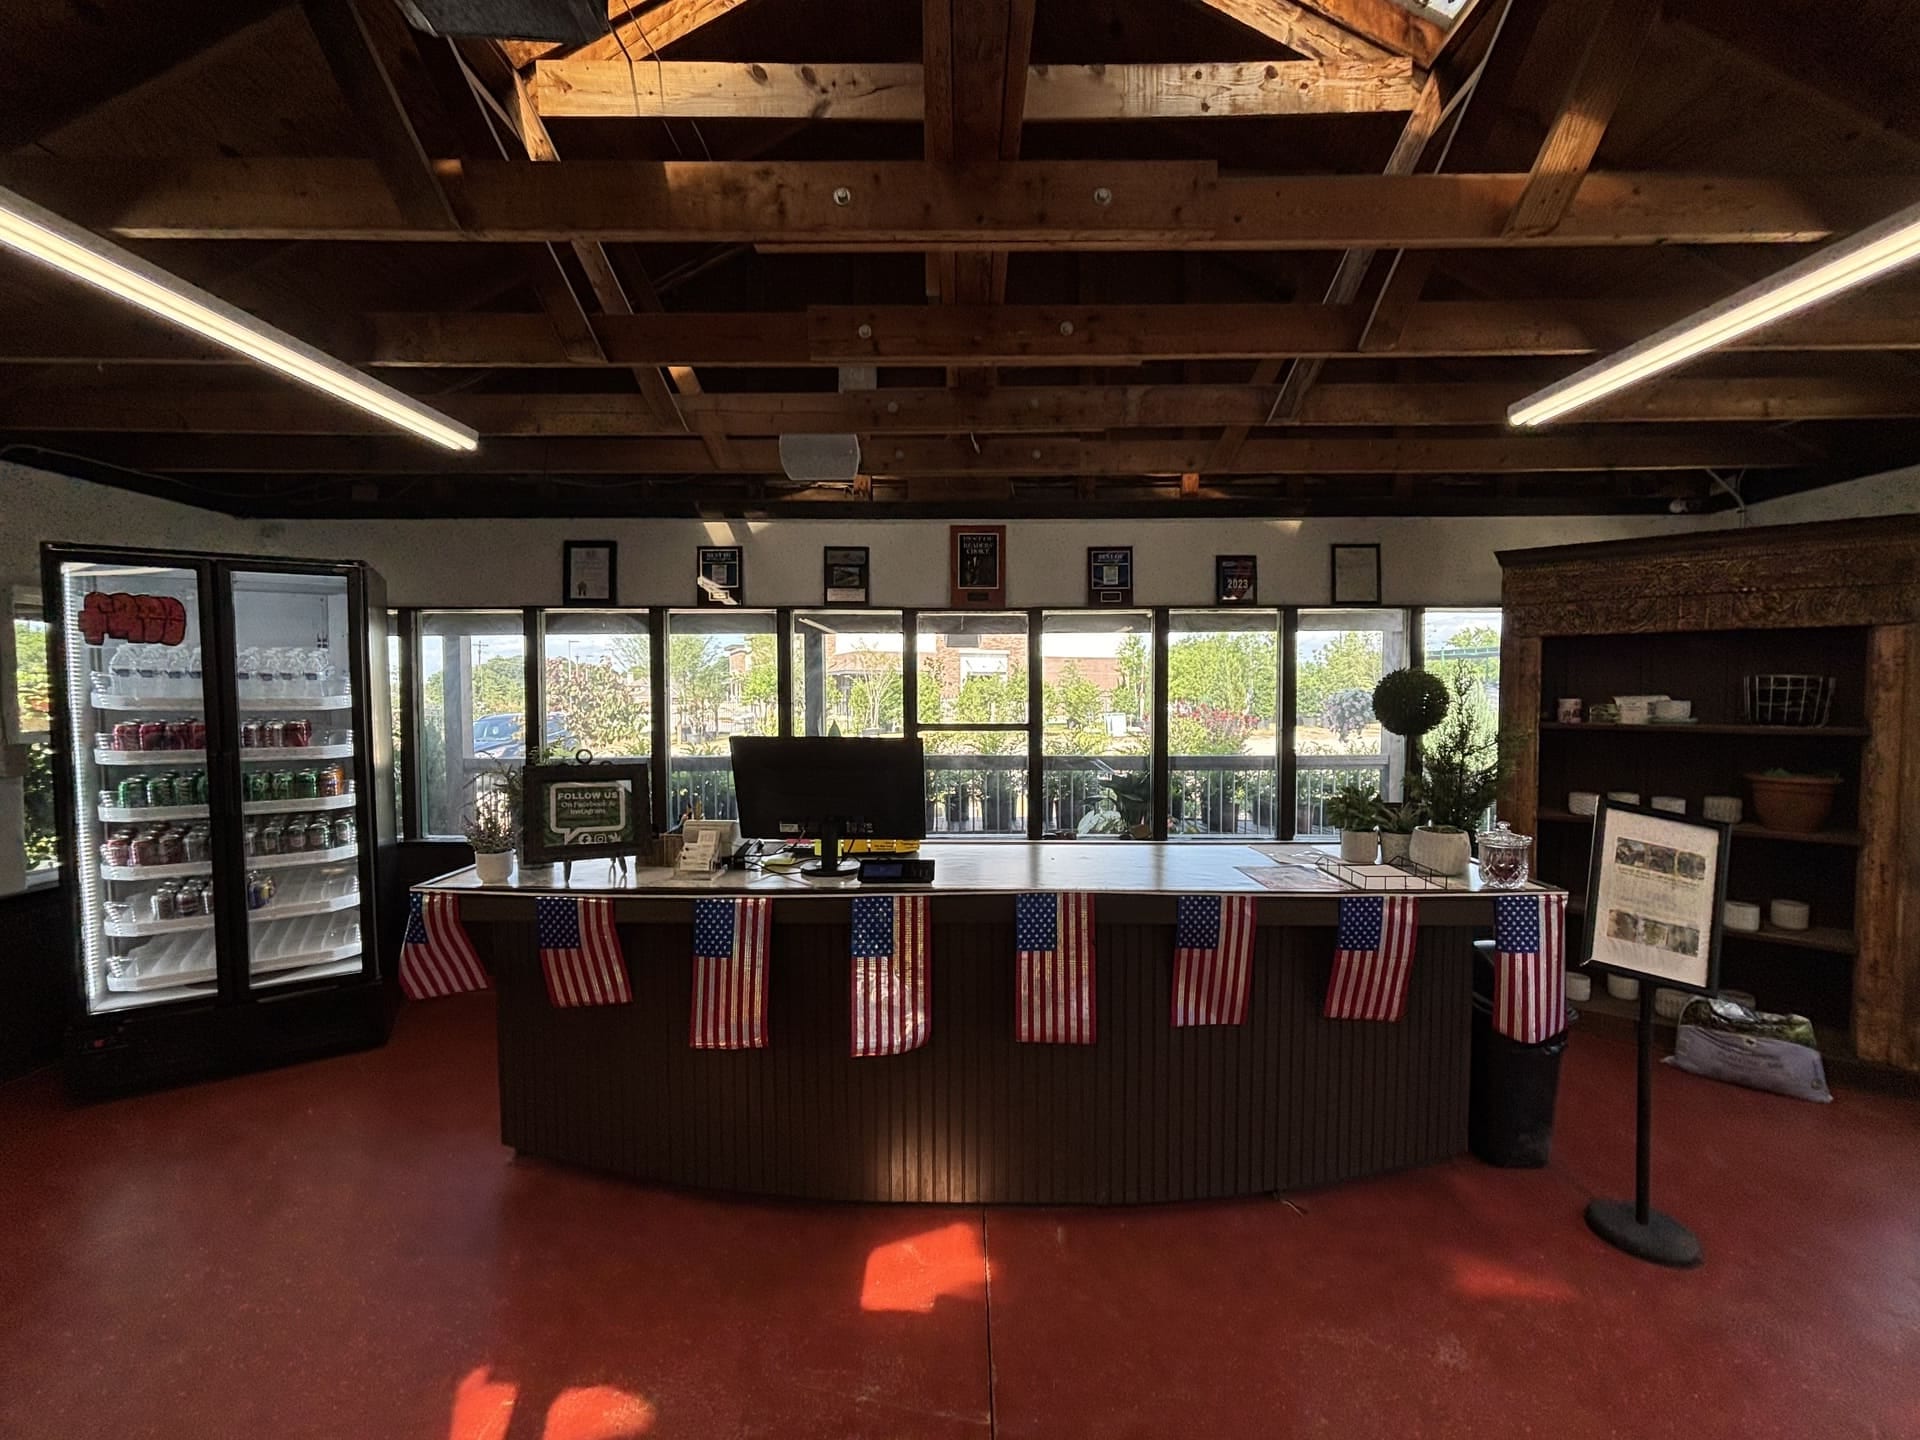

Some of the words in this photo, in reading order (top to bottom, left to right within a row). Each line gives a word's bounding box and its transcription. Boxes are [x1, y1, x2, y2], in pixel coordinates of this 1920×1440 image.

[1227, 578, 1248, 589] 2023
[558, 792, 601, 800] FOLLOW
[604, 791, 618, 799] US
